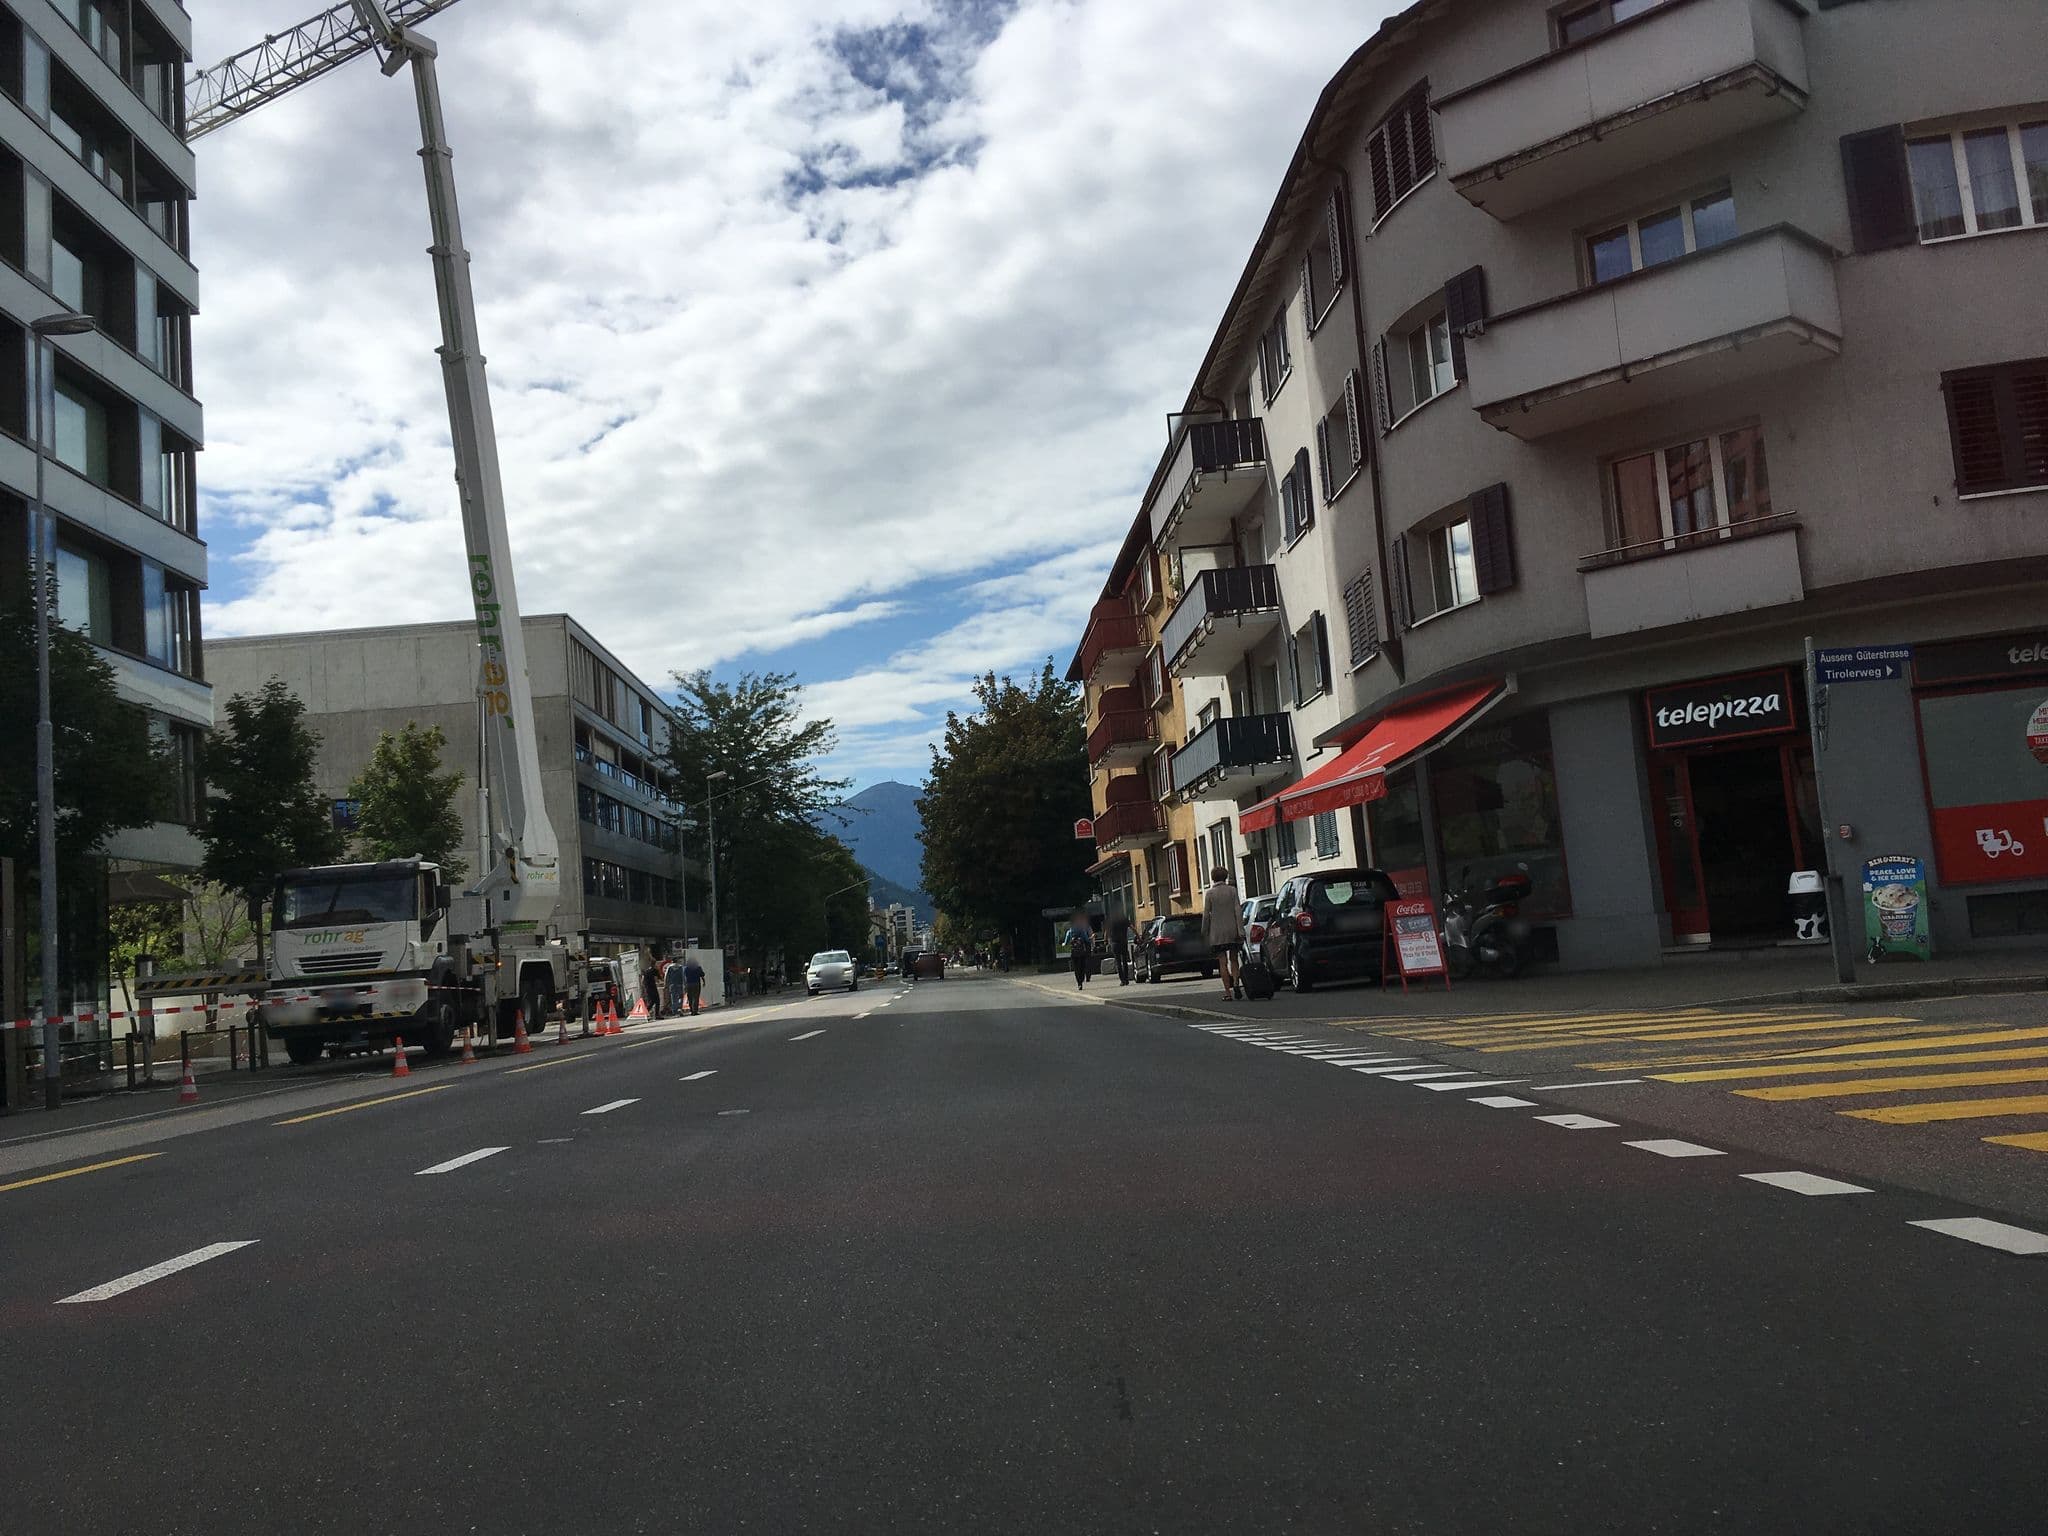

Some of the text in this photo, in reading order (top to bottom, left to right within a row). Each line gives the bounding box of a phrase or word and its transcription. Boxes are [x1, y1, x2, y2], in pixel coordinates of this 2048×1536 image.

[469, 554, 502, 652] rohr
[1820, 650, 1909, 663] Äussere Güterstrasse
[1825, 669, 1882, 679] Tirolerweg
[1656, 694, 1780, 728] telepizza
[526, 871, 544, 881] rohr
[304, 929, 364, 944] rohr ag
